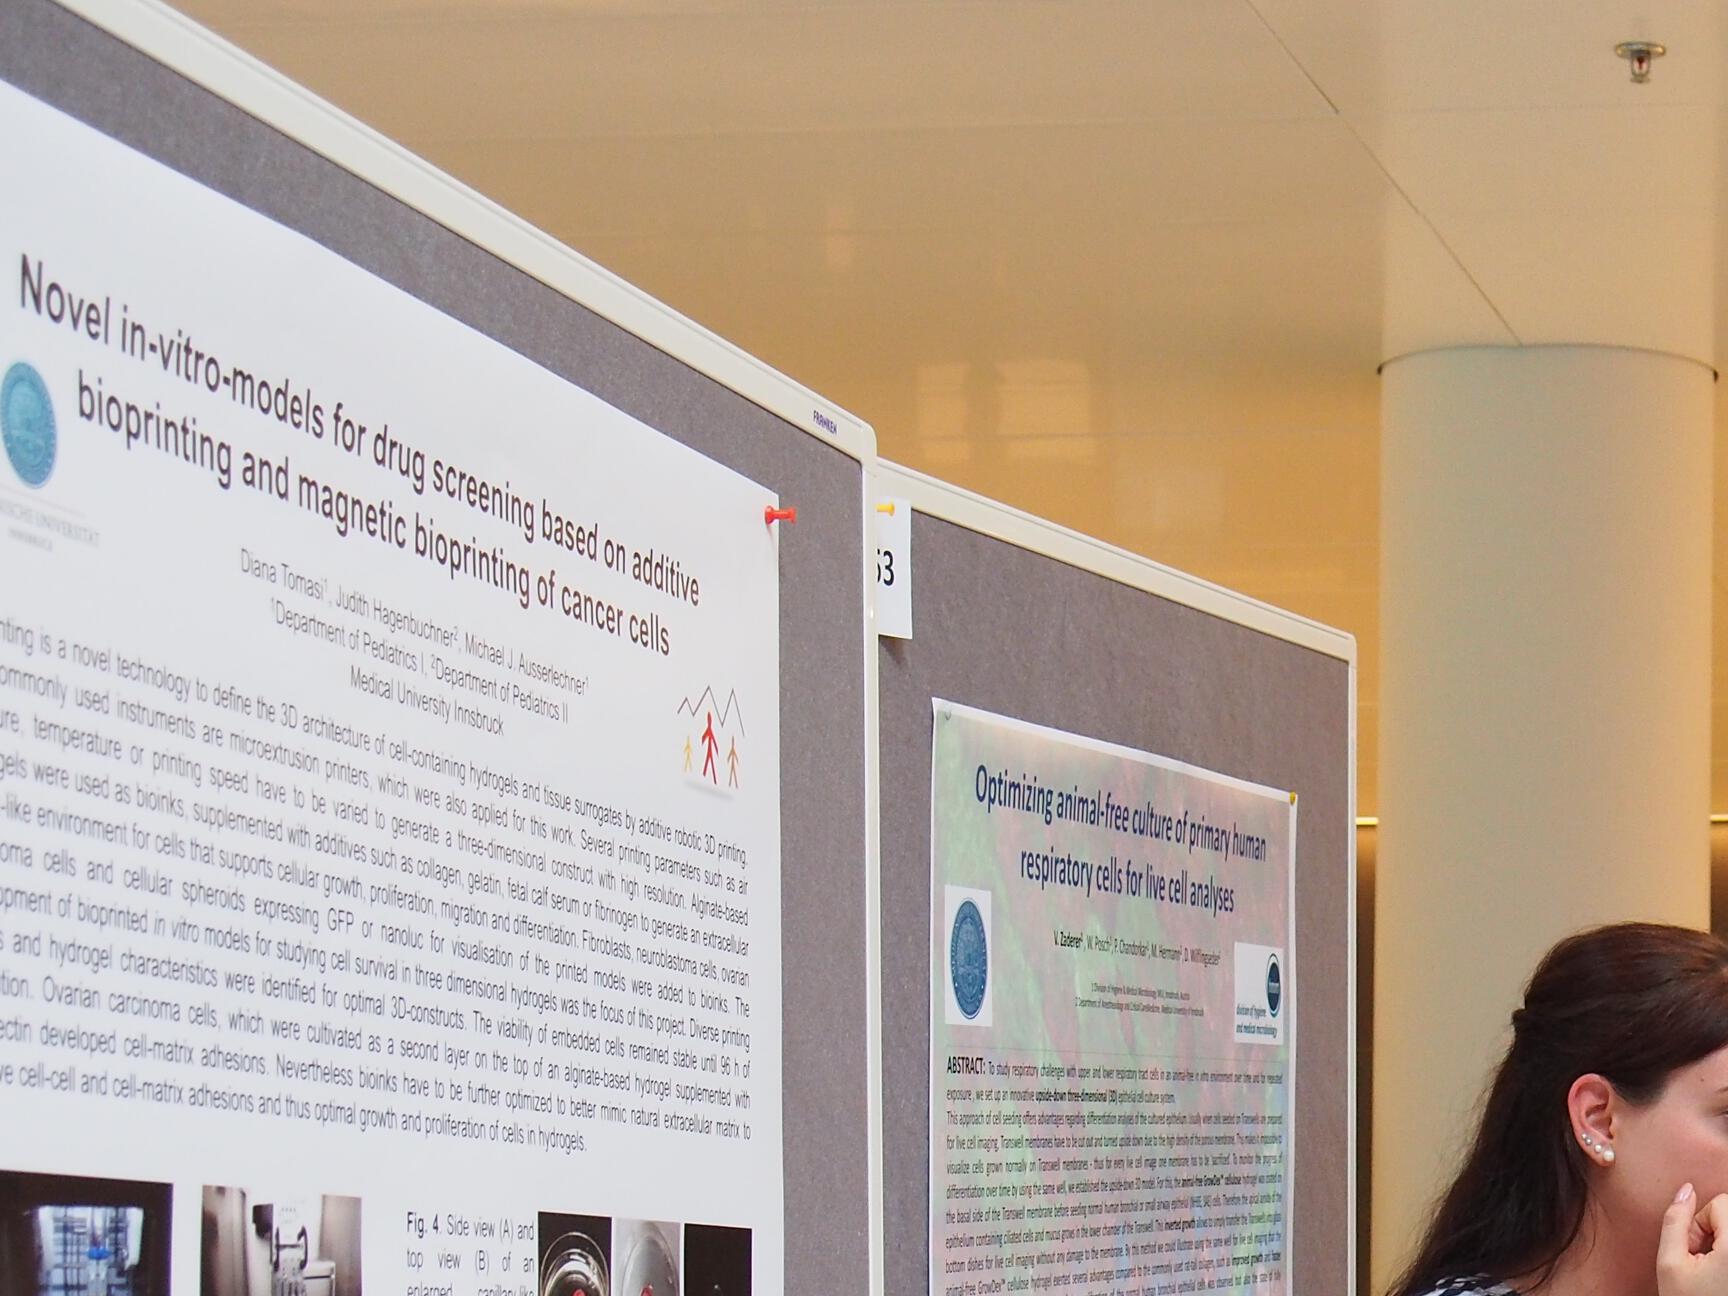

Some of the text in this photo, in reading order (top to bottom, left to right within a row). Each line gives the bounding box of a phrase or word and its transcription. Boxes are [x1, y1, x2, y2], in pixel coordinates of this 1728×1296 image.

[21, 253, 699, 606] Novel in-vitro-models for drug screening based on additive
[813, 410, 838, 435] FRANKEN
[79, 369, 670, 656] bioprinting and magnetic bioprinting of cancer cells
[241, 548, 277, 583] Diana
[336, 585, 369, 617] Judith
[466, 632, 504, 666] Michael
[349, 629, 360, 651] of
[363, 632, 417, 672] Pediatrics
[500, 682, 510, 702] of
[513, 685, 560, 721] Pediatrics
[350, 664, 504, 736] Medical University Innsbruck
[40, 626, 51, 654] is
[58, 639, 67, 660] a
[73, 642, 111, 672] novel
[116, 653, 191, 703] technology
[196, 678, 208, 702] to
[213, 684, 252, 716] define
[256, 697, 276, 723] the
[280, 703, 298, 729] 3D
[303, 712, 370, 751] architecture
[375, 734, 386, 757] of
[389, 741, 466, 785] cell-containing
[470, 759, 519, 796] hydrogels
[522, 775, 540, 802] and
[544, 784, 572, 812] tissue
[575, 794, 623, 830] surrogates
[625, 809, 635, 837] by
[639, 810, 672, 843] additive
[674, 821, 702, 852] robotic
[704, 833, 716, 855] 3D
[976, 764, 1266, 862] Optimizing animal-free culture of primary human
[1021, 846, 1234, 918] respiratory cells for live cell analyses
[947, 1056, 1065, 1080] ABSTRACT: To study respiratory challenges
[407, 1212, 429, 1237] Fig.
[446, 1215, 469, 1239] Side
[474, 1217, 495, 1239] view
[499, 1218, 513, 1240] (A)
[517, 1220, 534, 1241] and
[407, 1251, 534, 1275] top view (B) of an
